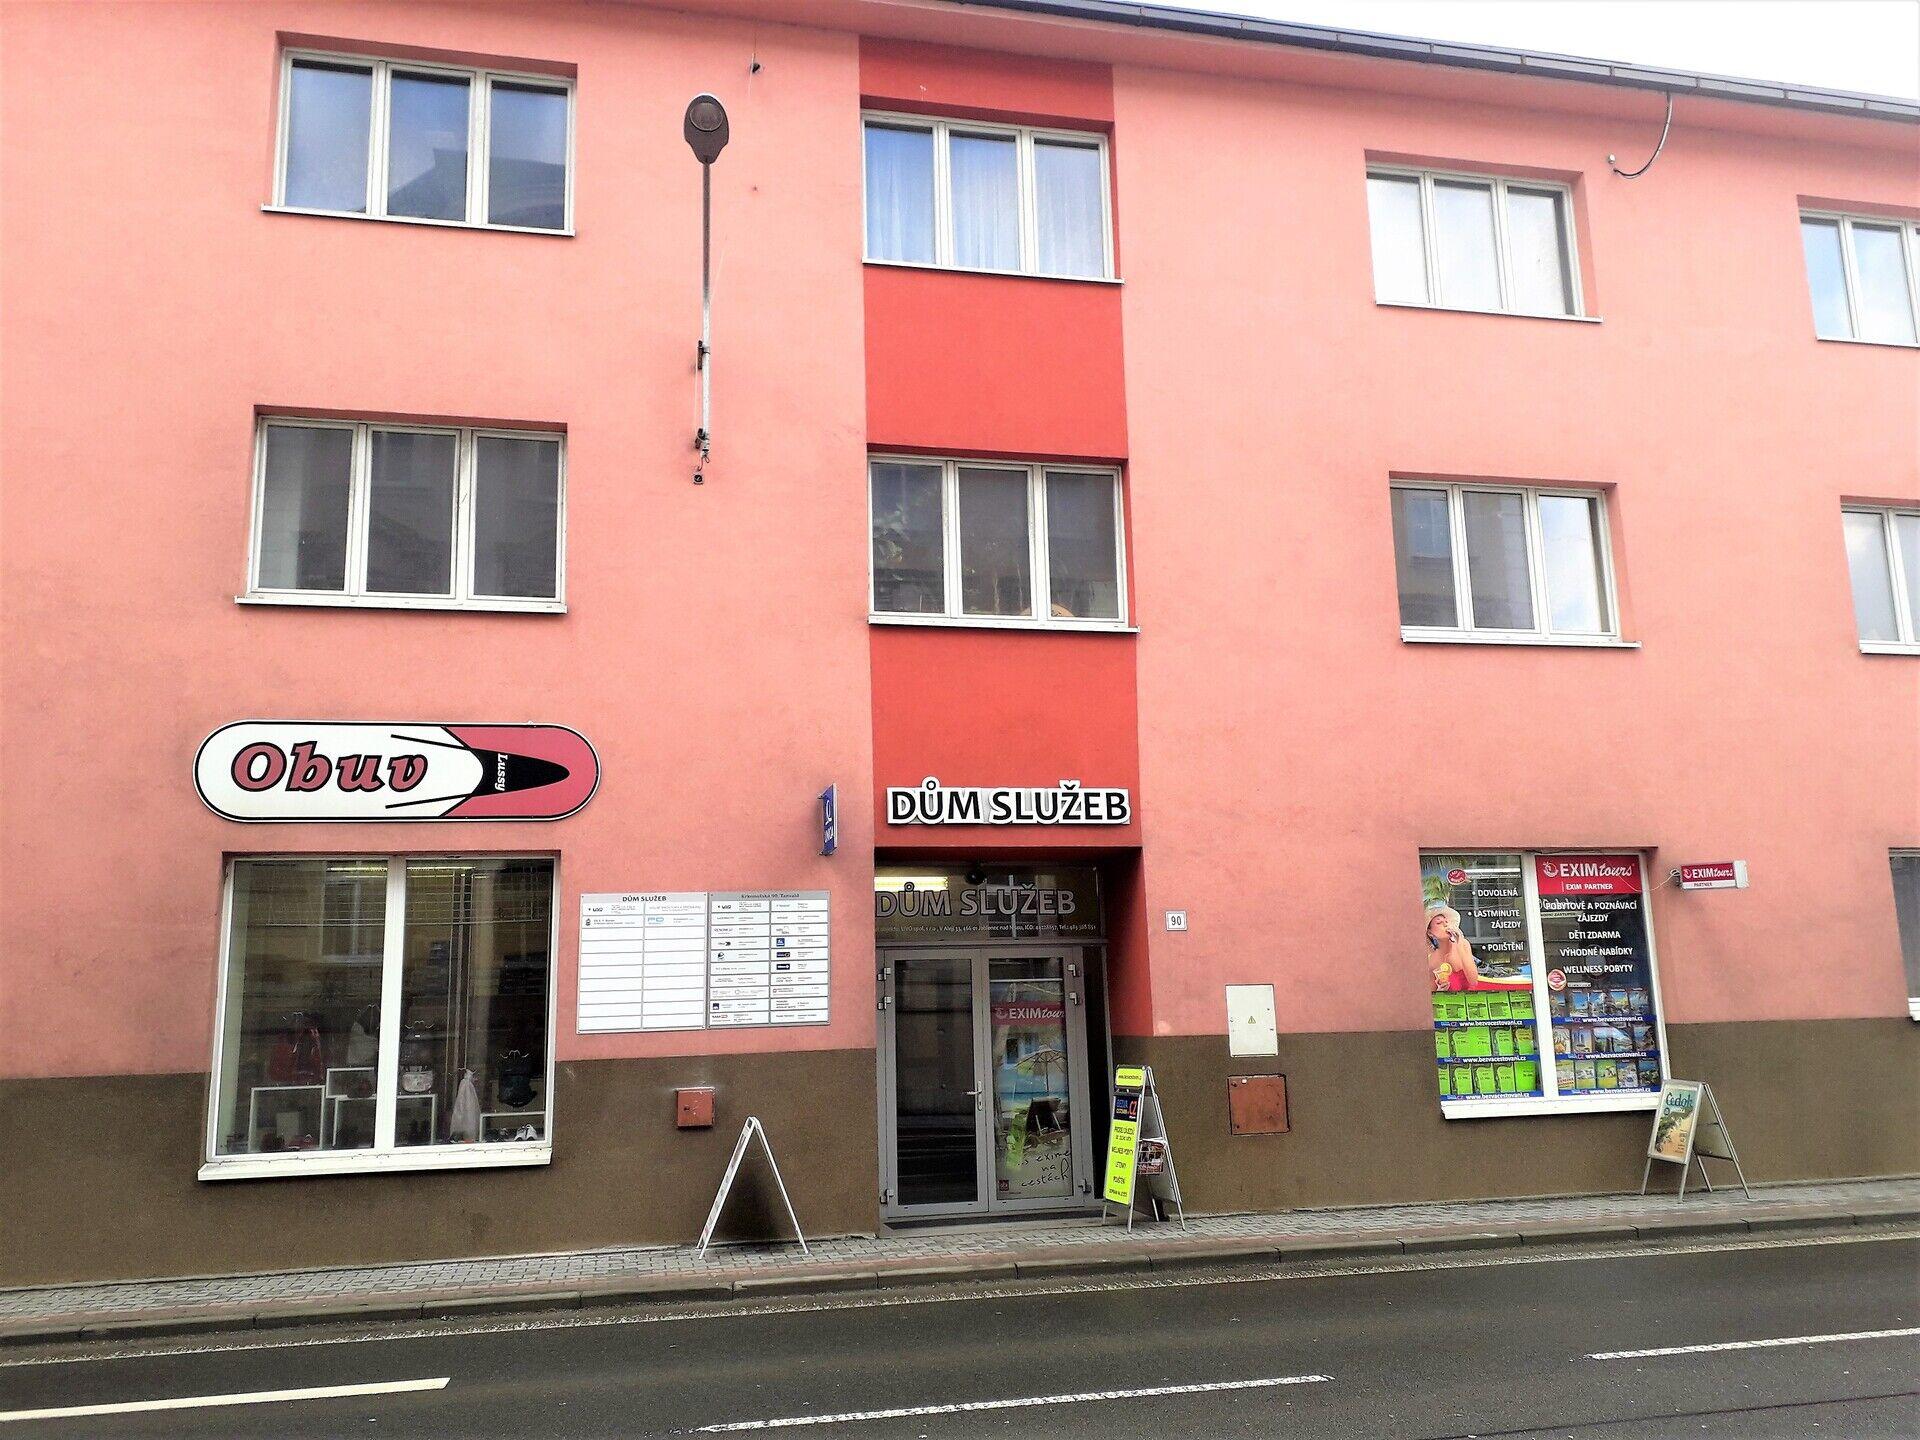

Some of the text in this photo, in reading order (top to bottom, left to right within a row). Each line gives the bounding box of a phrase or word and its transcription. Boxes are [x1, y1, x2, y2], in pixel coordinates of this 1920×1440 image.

[230, 740, 428, 792] Obuv
[495, 753, 509, 792] Lussy
[892, 780, 1128, 821] DŮM SLUŽEB
[1560, 862, 1632, 877] EXIMtours
[1477, 887, 1519, 897] DOVOLENÁ
[875, 881, 1076, 918] DŮM SLUŽEB
[1546, 900, 1637, 910] POBYTOVÉ A POZNÁVACÍ
[1473, 909, 1520, 918] LASTMINUTE
[1577, 913, 1608, 922] ZÁJEZDY
[1171, 916, 1181, 925] 90
[1490, 919, 1521, 929] ZÁJEZDY
[1568, 929, 1621, 940] DĚTI ZDARMA
[1487, 941, 1524, 951] POJIŠTĚNÍ
[1560, 945, 1633, 957] VÝHODNÉ NABÍDKY
[1563, 964, 1633, 974] WELLNESS POBYTY
[1665, 1092, 1693, 1107] Čedok
[1021, 1158, 1069, 1187] cestách
